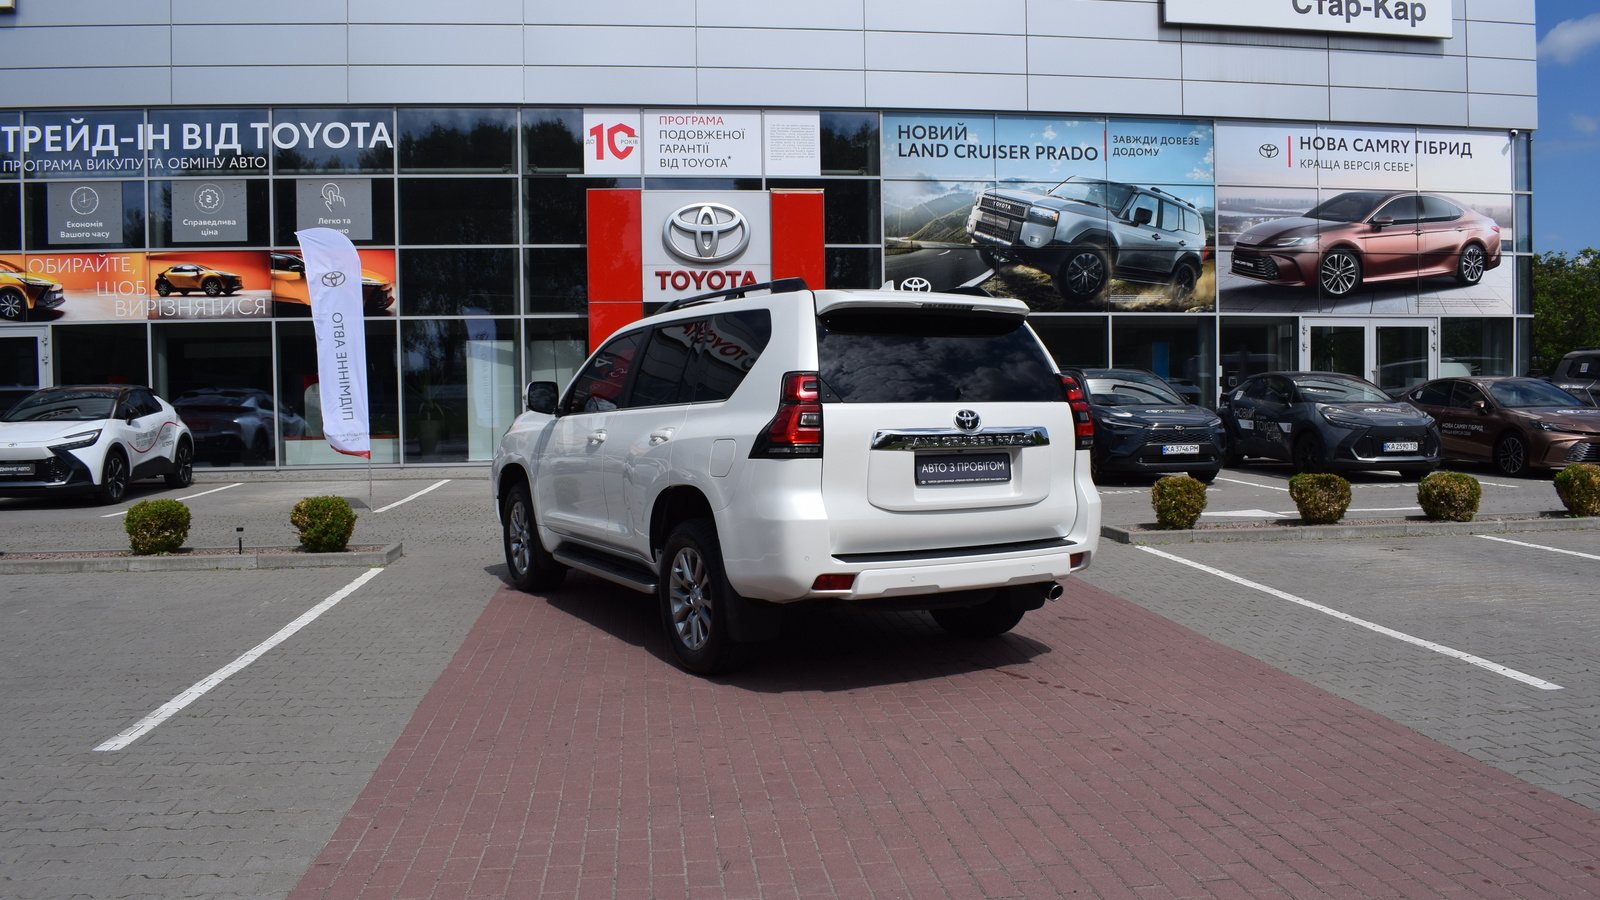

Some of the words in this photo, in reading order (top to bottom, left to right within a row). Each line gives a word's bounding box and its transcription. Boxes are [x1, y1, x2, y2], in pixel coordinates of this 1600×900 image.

[659, 116, 724, 125] ПРОГРАМА
[1, 118, 170, 157] ТРЕЙД-ІН
[182, 123, 241, 155] ВІД
[250, 122, 394, 150] TOYOTA
[659, 128, 746, 141] ПОДОВЖЕНОЇ
[898, 122, 967, 141] НОВИЙ
[1112, 135, 1158, 145] ЗАВЖДИ
[1160, 136, 1200, 146] ДОВЕЗЕ
[659, 142, 710, 153] ГАРАНТІЇ
[898, 143, 949, 158] LAND
[954, 144, 1030, 160] CRUISER
[1035, 145, 1098, 161] PRADO
[1112, 147, 1160, 157] ДОДОМУ
[1300, 136, 1348, 151] НОВА
[1353, 138, 1410, 154] CAMRY
[1415, 140, 1472, 159] ГІБРИД
[3, 158, 83, 172] ПРОГРАМА
[87, 158, 144, 171] ВИКУПУ
[148, 158, 164, 170] ТА
[168, 157, 226, 169] ОБМІНУ
[229, 156, 267, 168] АВТО
[660, 158, 679, 169] ВІД
[1300, 159, 1341, 171] КРАЩА
[1344, 160, 1380, 171] ВЕРСІЯ
[182, 218, 237, 227] Справедлива
[318, 217, 341, 225] Легко
[92, 231, 110, 239] часу
[201, 228, 218, 236] ціна
[28, 254, 136, 275] ОБИРАЙТЕ,
[655, 270, 757, 290] TOYOTA
[96, 280, 147, 298] ЩОБ
[115, 298, 267, 317] ВИРІЗНЯТИСЯ
[922, 463, 947, 474] АВТО
[949, 463, 955, 472] З
[957, 461, 1005, 472] ПРОБІГОМ
